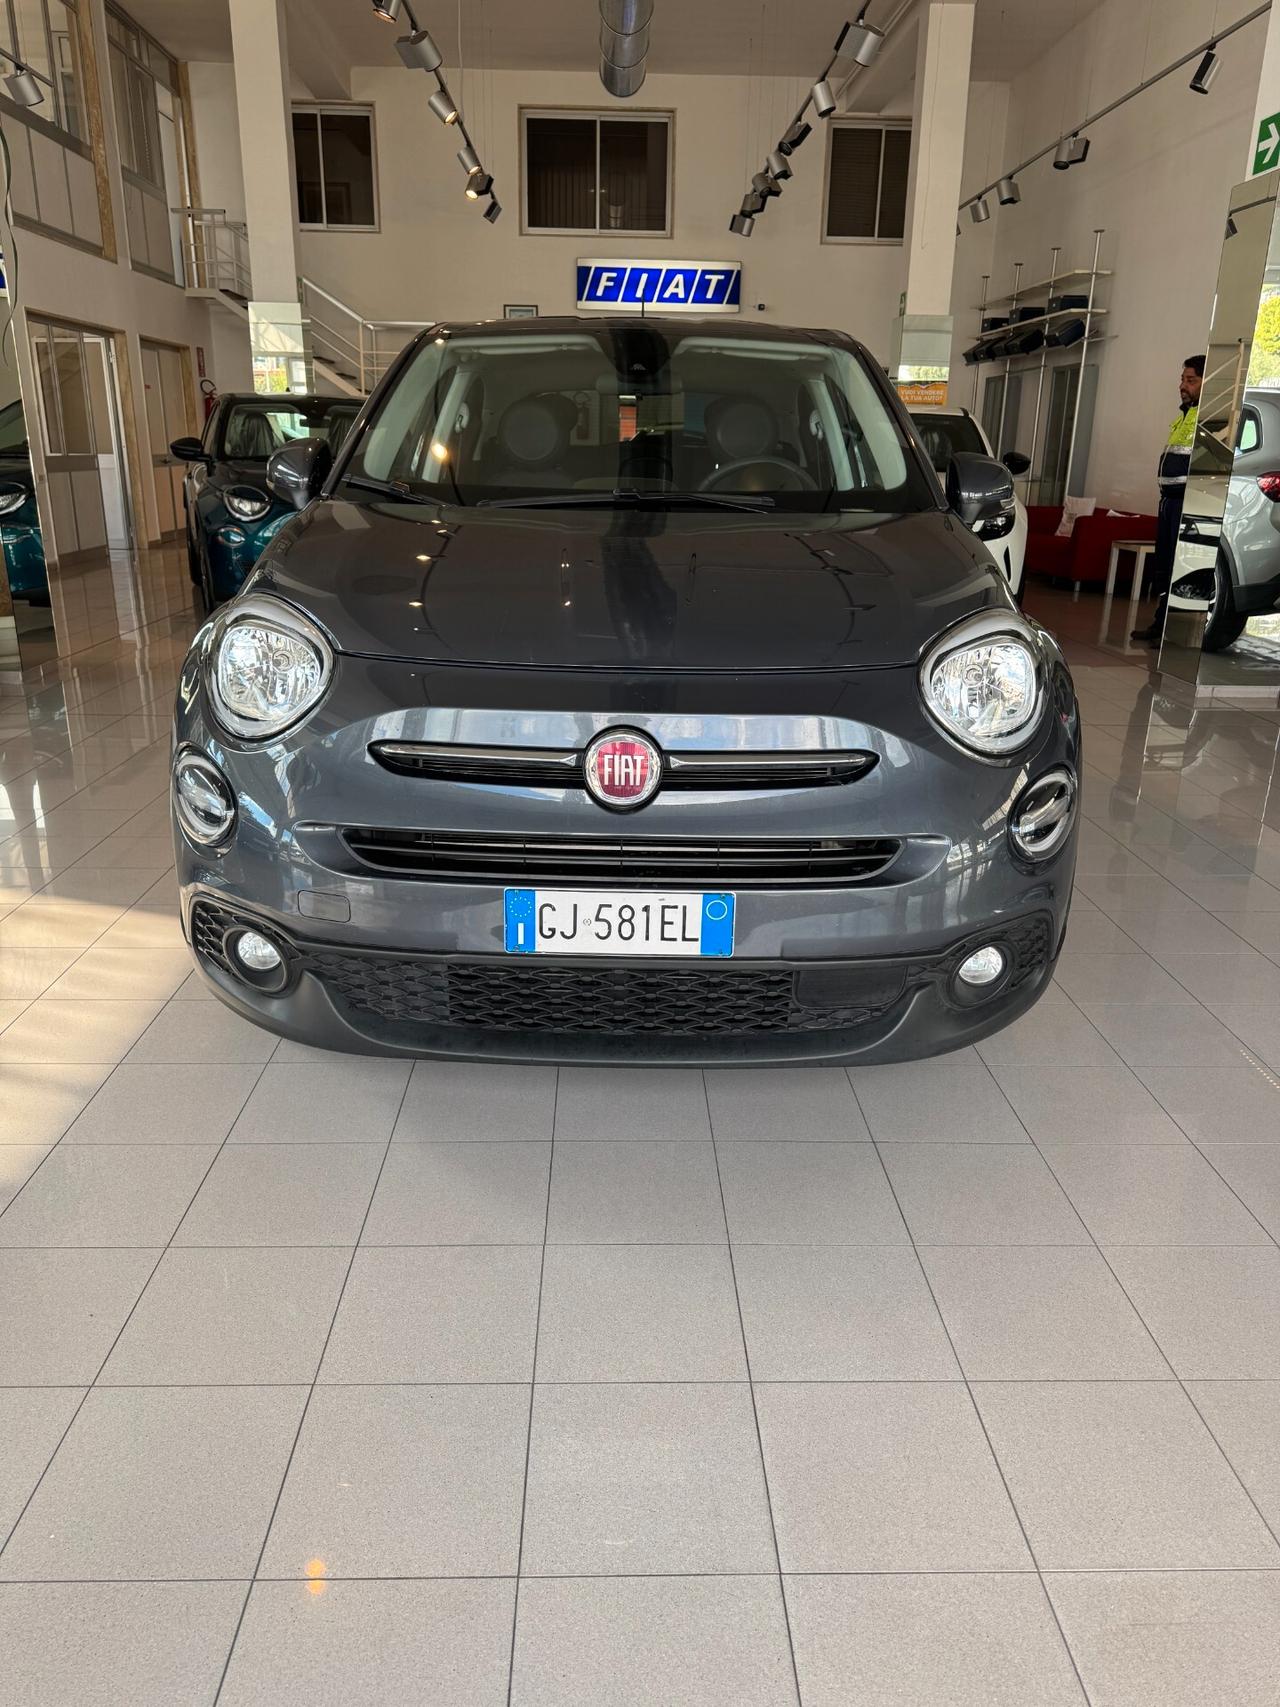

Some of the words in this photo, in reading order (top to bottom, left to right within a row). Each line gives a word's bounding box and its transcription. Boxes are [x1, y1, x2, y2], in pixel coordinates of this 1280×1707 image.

[595, 272, 725, 299] FIAT
[603, 754, 645, 786] FIAT
[538, 902, 578, 940] GJ
[594, 903, 700, 943] 581EL
